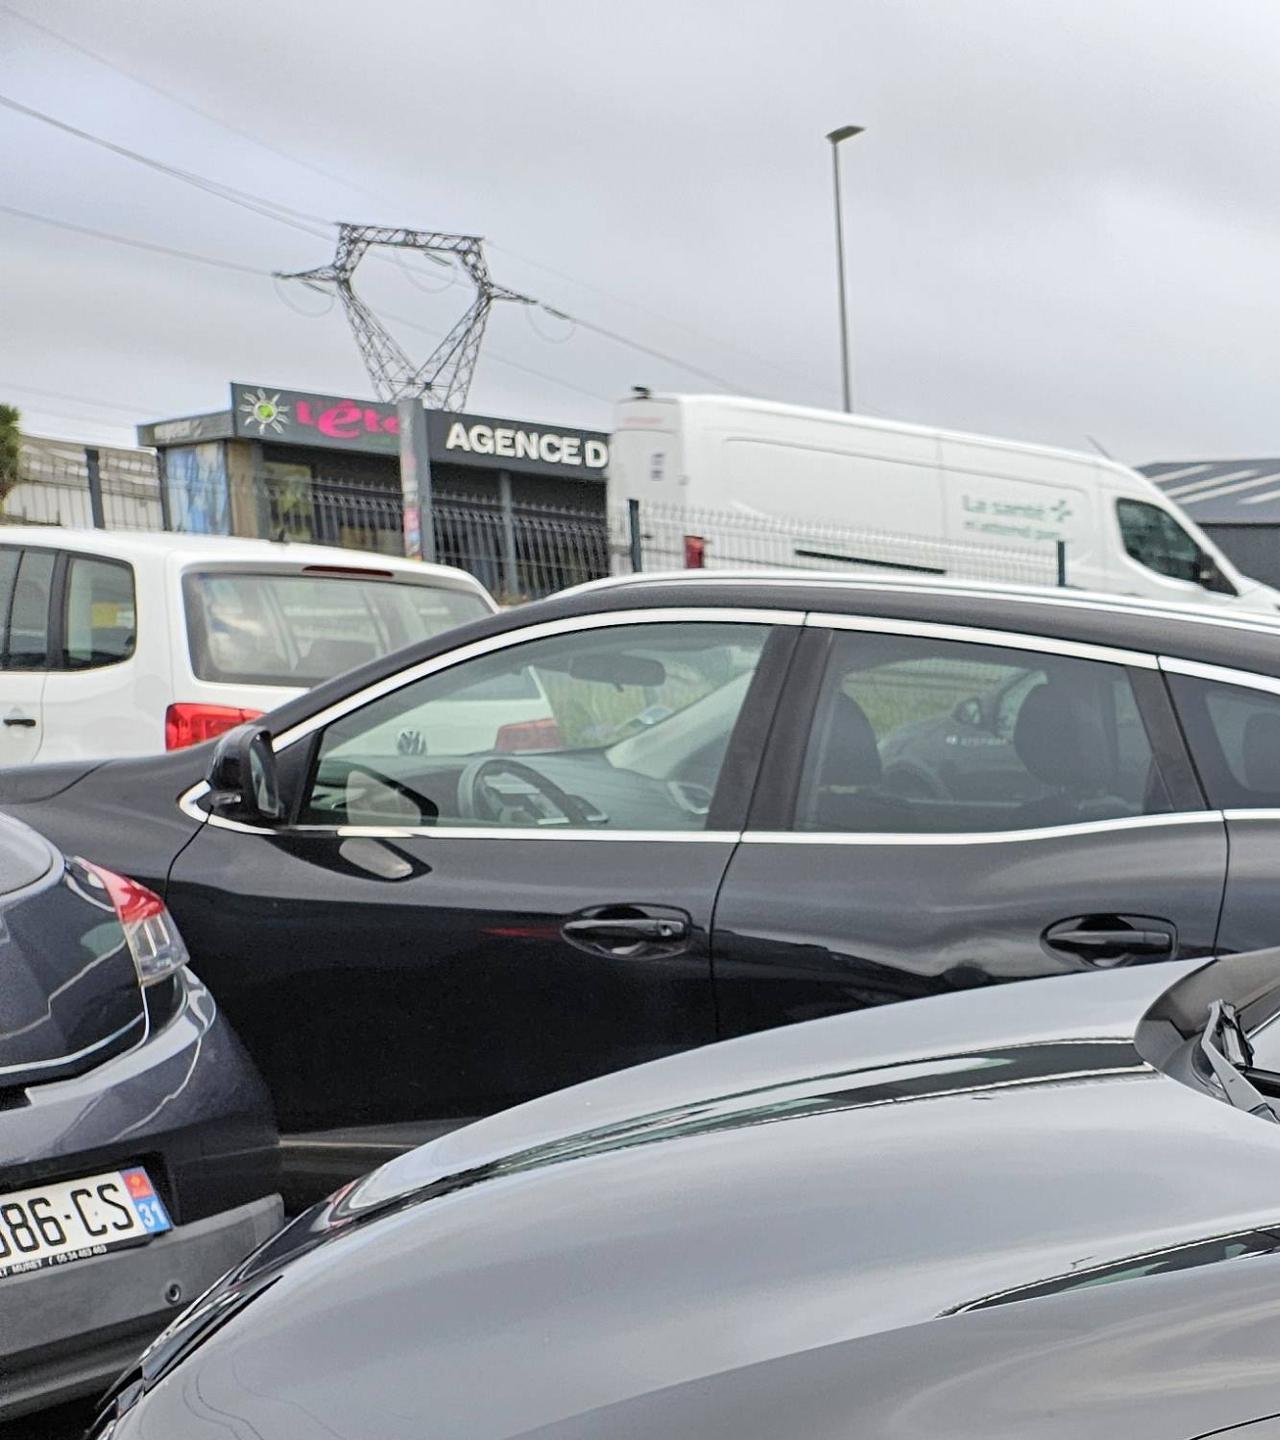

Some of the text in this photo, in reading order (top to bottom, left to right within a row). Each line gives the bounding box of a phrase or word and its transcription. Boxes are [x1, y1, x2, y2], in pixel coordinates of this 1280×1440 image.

[446, 421, 610, 469] AGENCE D
[138, 1201, 166, 1229] 31
